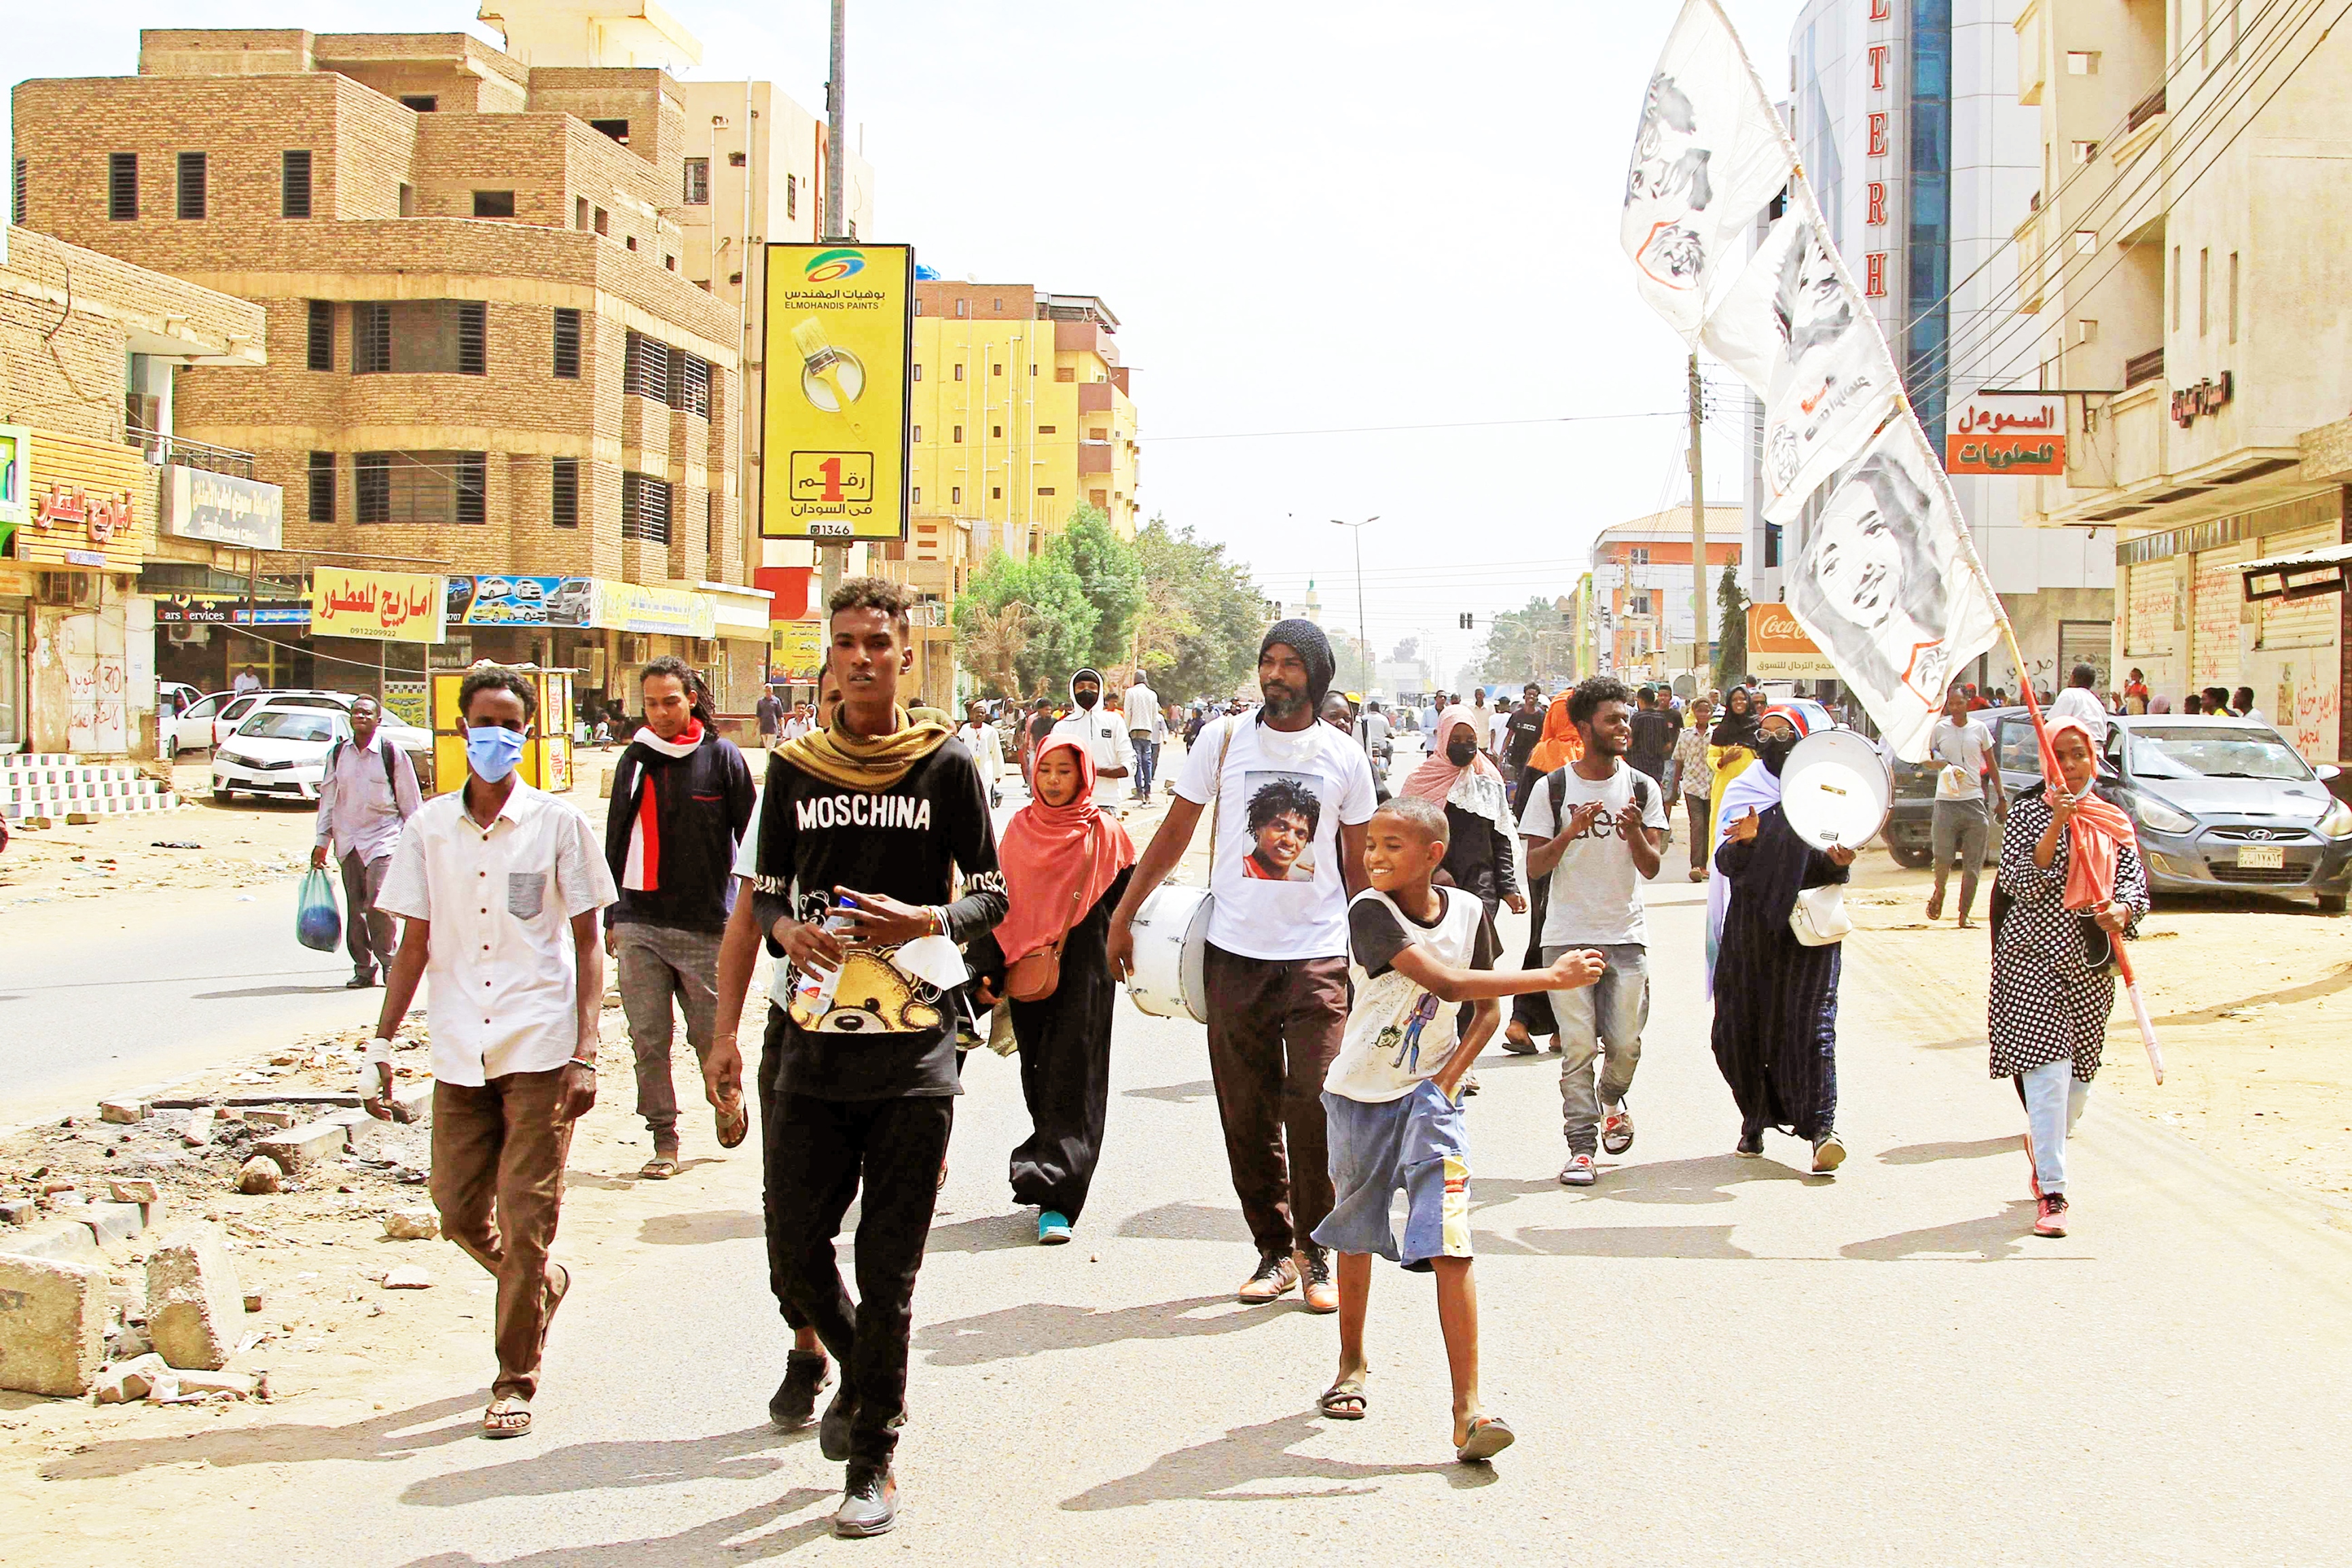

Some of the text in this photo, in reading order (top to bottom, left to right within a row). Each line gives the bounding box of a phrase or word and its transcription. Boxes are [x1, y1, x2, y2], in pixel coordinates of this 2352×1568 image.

[784, 289, 885, 300] بوهيات المهندس
[784, 302, 879, 310] ELMOHANDIS PAINTS
[1957, 441, 2056, 470] للحلويات
[819, 458, 844, 502] 1
[791, 503, 846, 517] السودان
[201, 514, 259, 542] Saudi Dental Clinic
[822, 525, 850, 535] 1346
[319, 578, 434, 628] أماريج للعطور
[157, 609, 181, 621] Cars
[183, 609, 225, 621] Services
[350, 627, 397, 638] 0912209922
[1757, 661, 1786, 671] للتسوق
[1788, 661, 1813, 671] الترحال
[102, 666, 122, 693] 30
[795, 794, 930, 831] MOSCHINA
